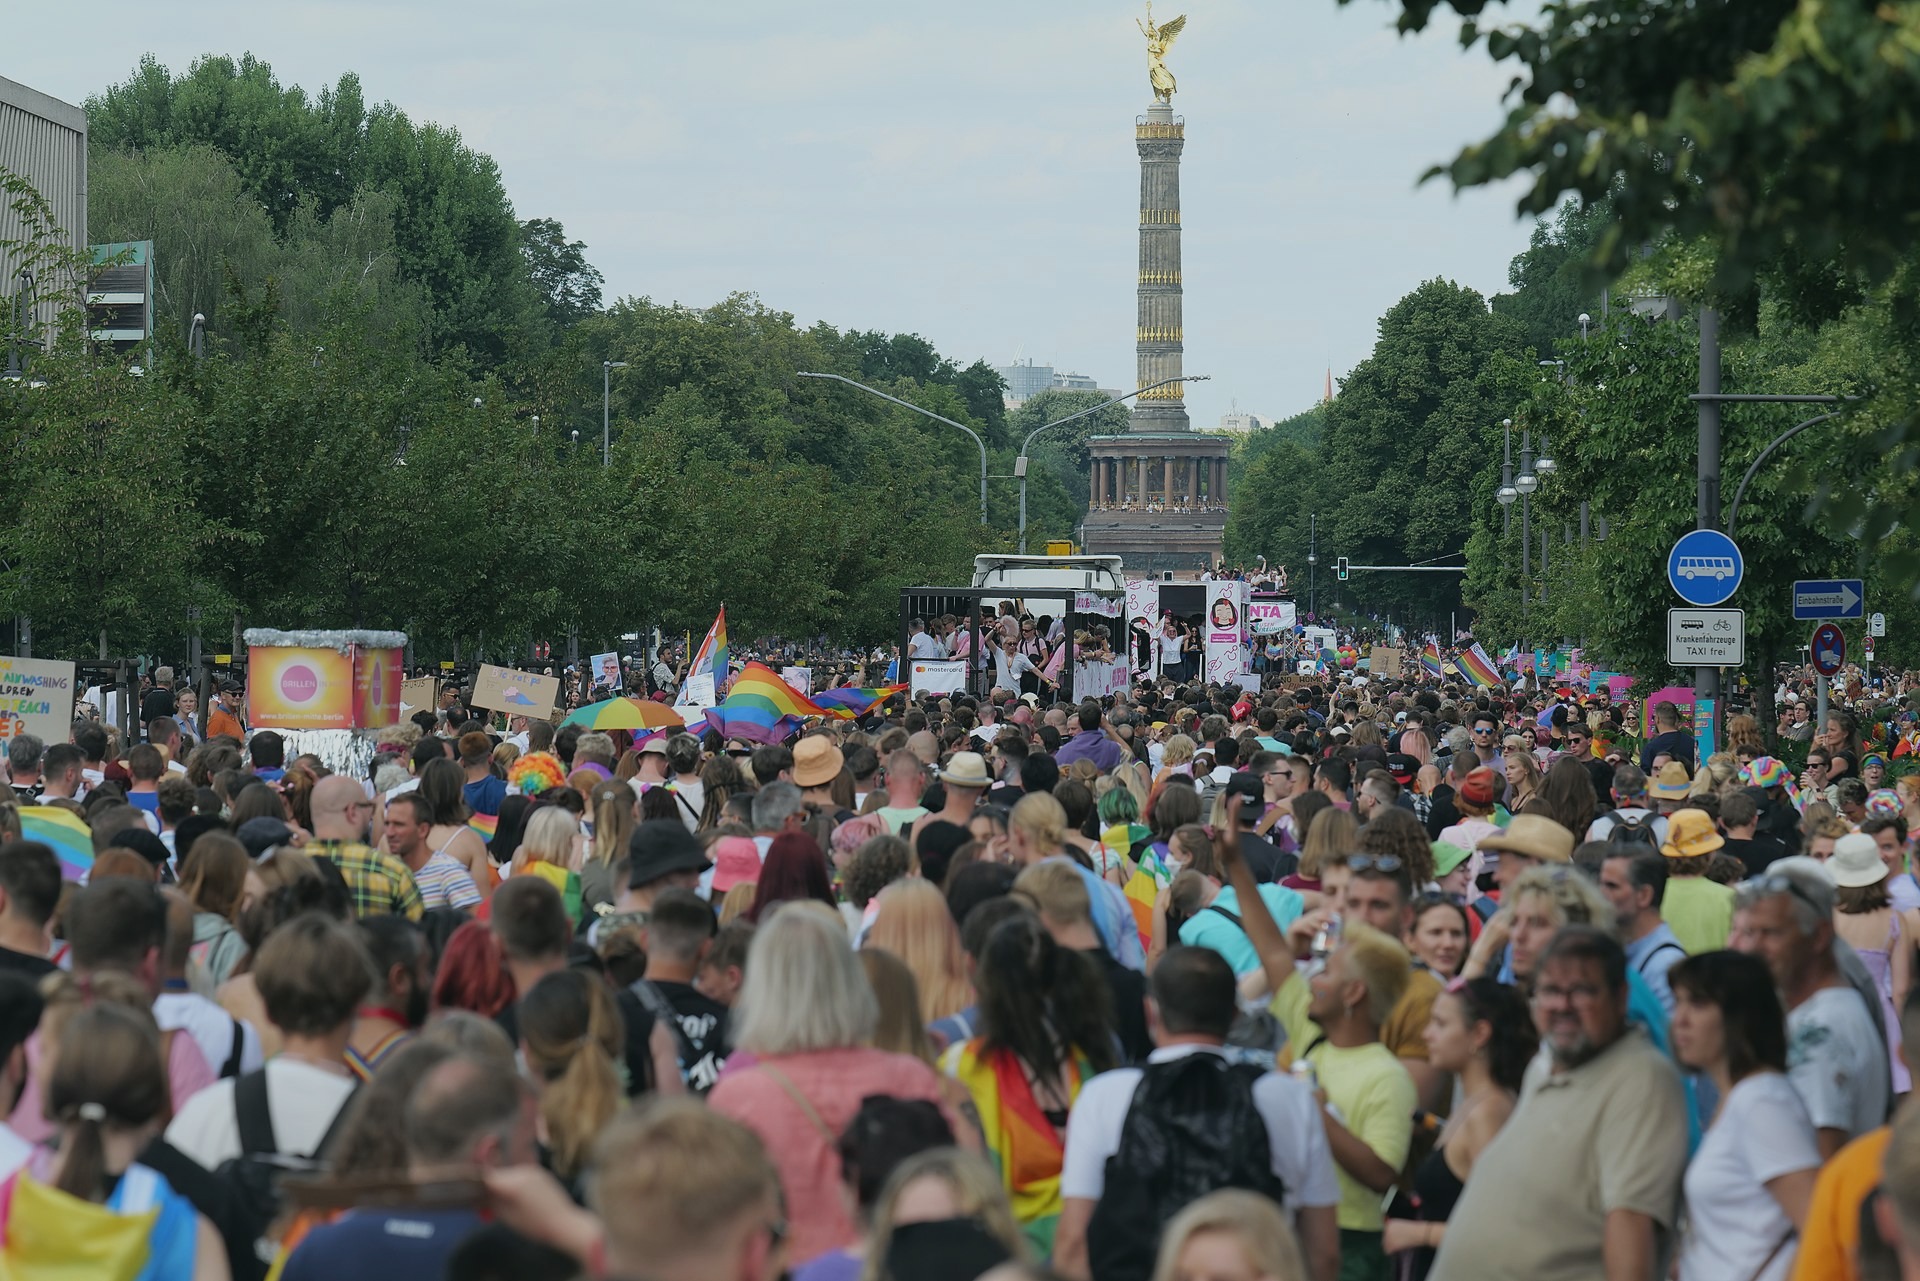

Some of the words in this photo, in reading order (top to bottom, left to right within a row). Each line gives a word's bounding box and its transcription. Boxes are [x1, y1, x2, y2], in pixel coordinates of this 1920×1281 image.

[1798, 595, 1844, 605] Einbahnstraße
[1675, 634, 1736, 646] Krankenfahrzeuge
[1687, 647, 1706, 656] TAXI
[1710, 647, 1726, 656] frei
[0, 672, 68, 689] AINWASHING
[282, 680, 316, 688] BRILLEN
[12, 699, 50, 714] TEACH
